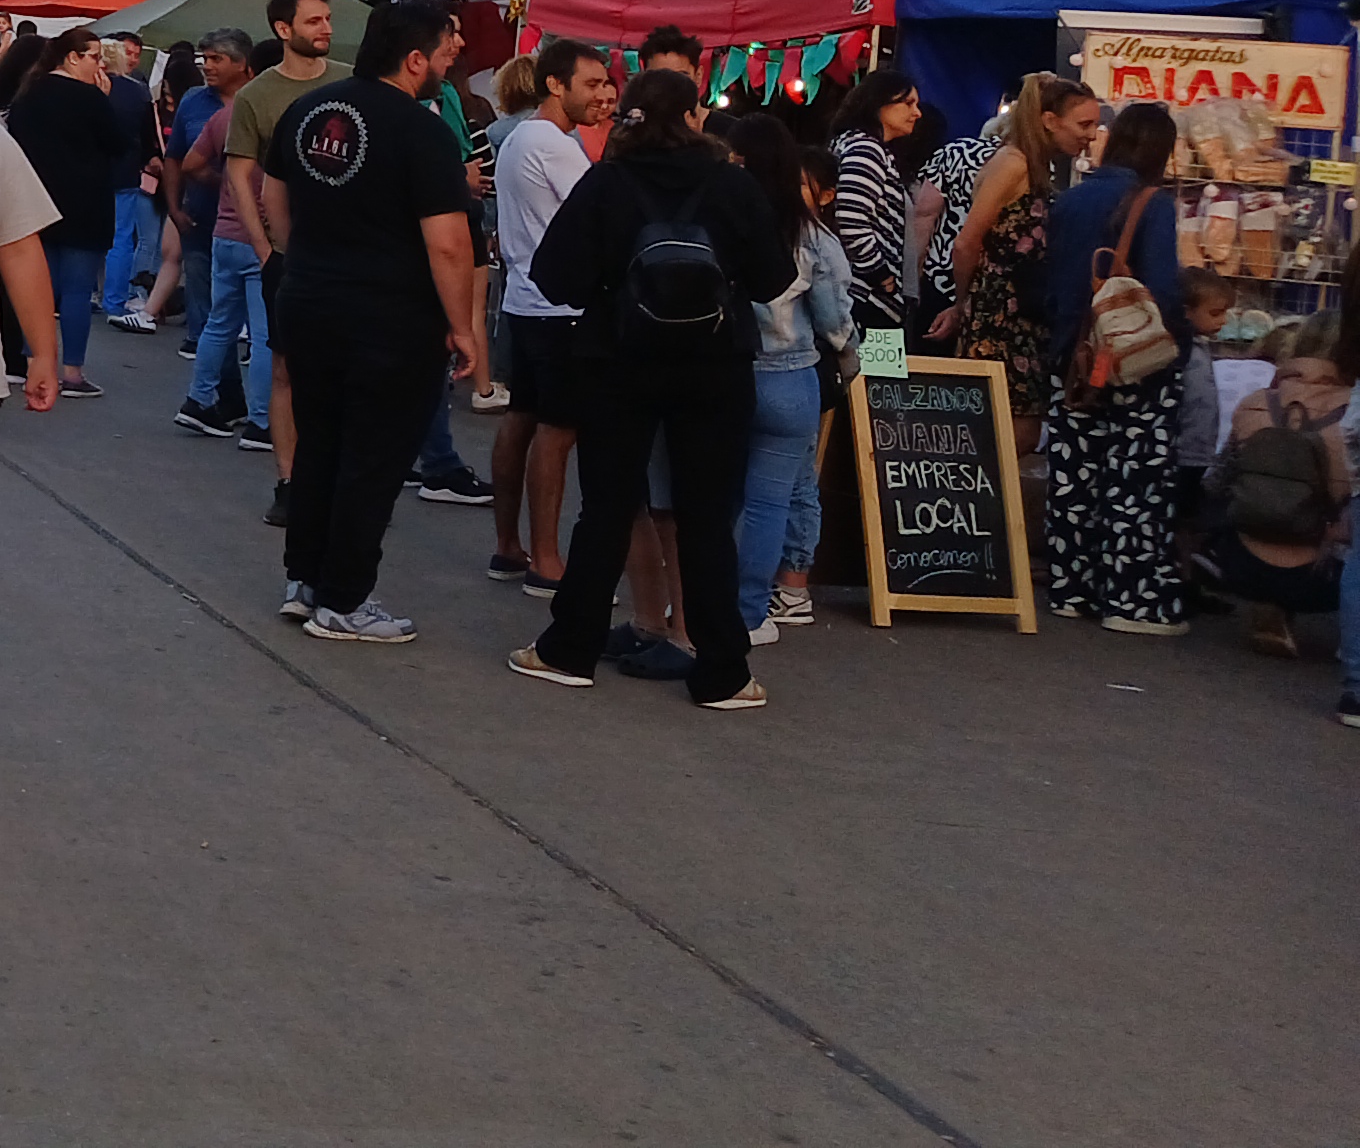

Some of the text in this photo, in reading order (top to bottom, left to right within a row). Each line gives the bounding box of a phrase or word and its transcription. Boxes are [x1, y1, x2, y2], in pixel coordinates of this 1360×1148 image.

[1093, 36, 1249, 67] Alpargatas
[1112, 65, 1325, 114] DIANA
[868, 383, 984, 414] CALZADOS
[886, 460, 995, 498] EMPRESA
[895, 497, 991, 536] LOCAL
